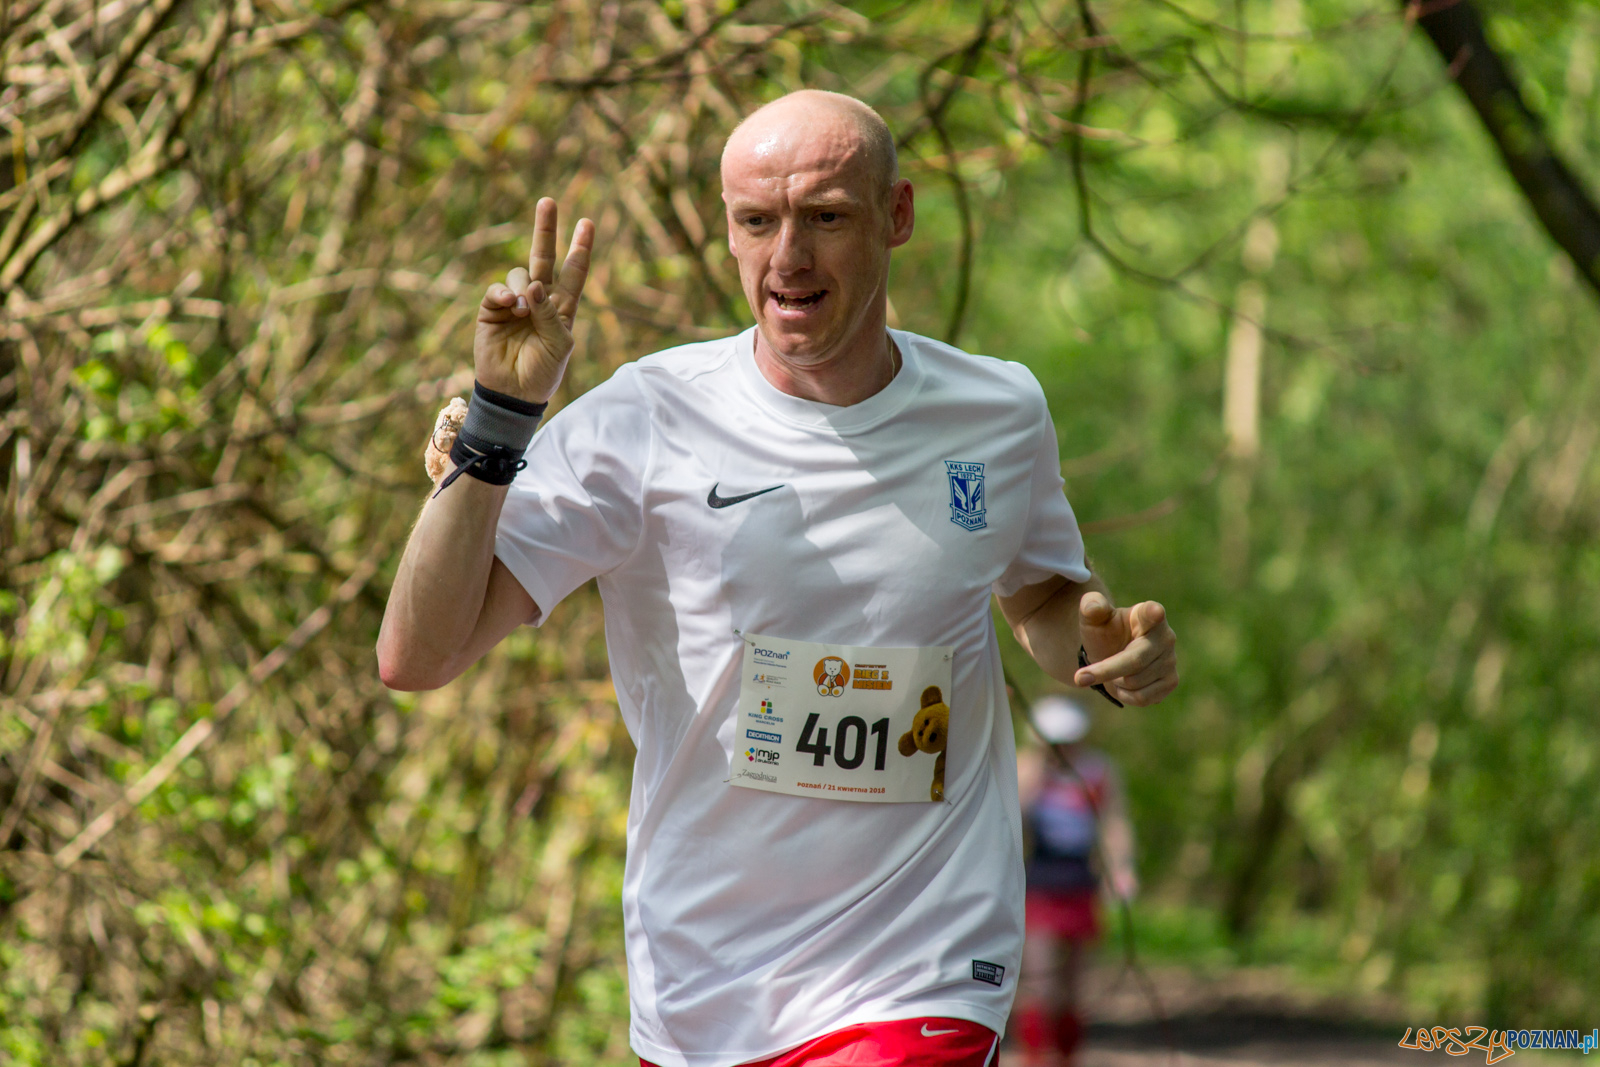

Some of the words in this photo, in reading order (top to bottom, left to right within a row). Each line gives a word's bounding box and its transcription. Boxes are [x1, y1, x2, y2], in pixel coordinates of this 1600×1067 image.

[949, 463, 963, 471] KKS
[964, 465, 982, 473] LECH
[854, 669, 879, 679] BIEG
[748, 712, 763, 720] KING
[763, 715, 784, 723] CROSS
[748, 731, 781, 742] DECATHLON
[795, 713, 890, 771] 401
[757, 749, 780, 761] mjp
